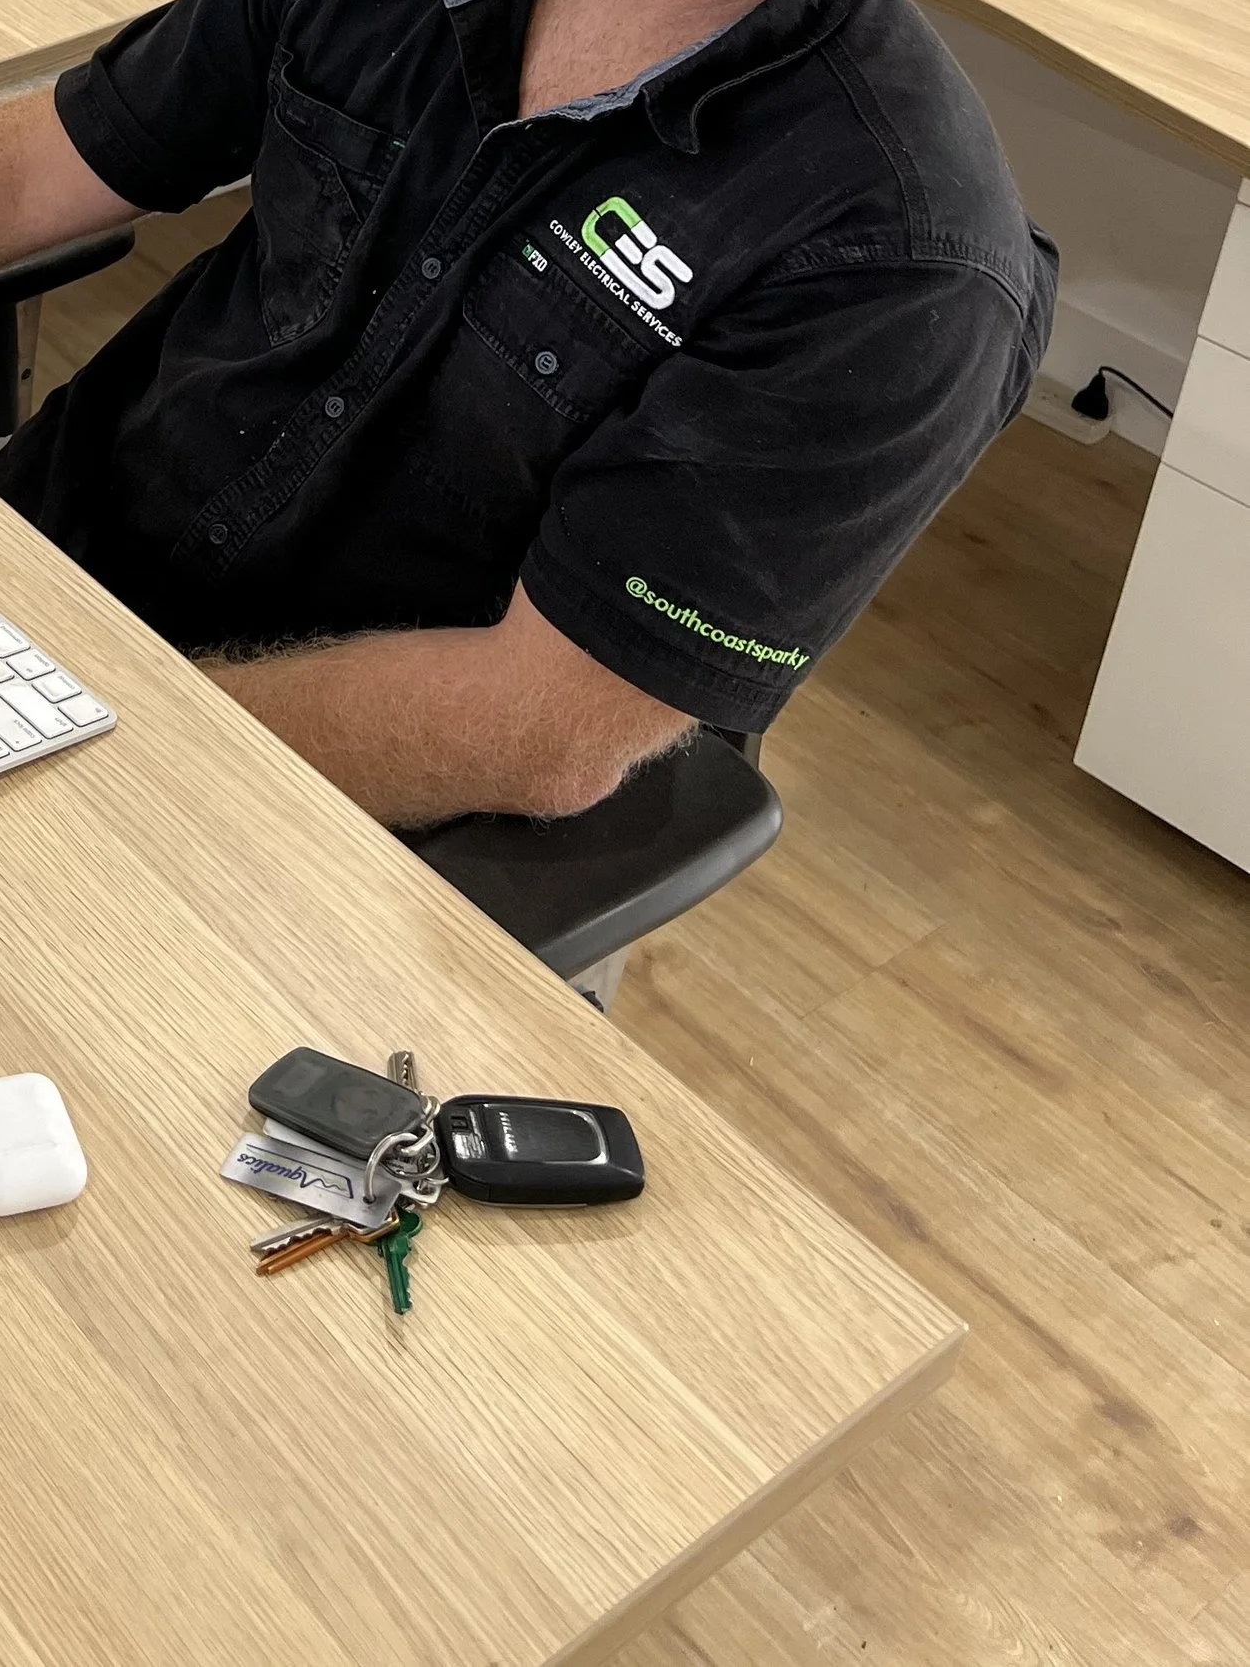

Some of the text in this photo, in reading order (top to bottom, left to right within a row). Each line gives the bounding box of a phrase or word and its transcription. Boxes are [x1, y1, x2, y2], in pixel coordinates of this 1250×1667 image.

[528, 249, 548, 272] FXD
[549, 219, 683, 347] COWLEY ELECTRICAL SERVICES
[626, 576, 810, 671] @southcoastsparky
